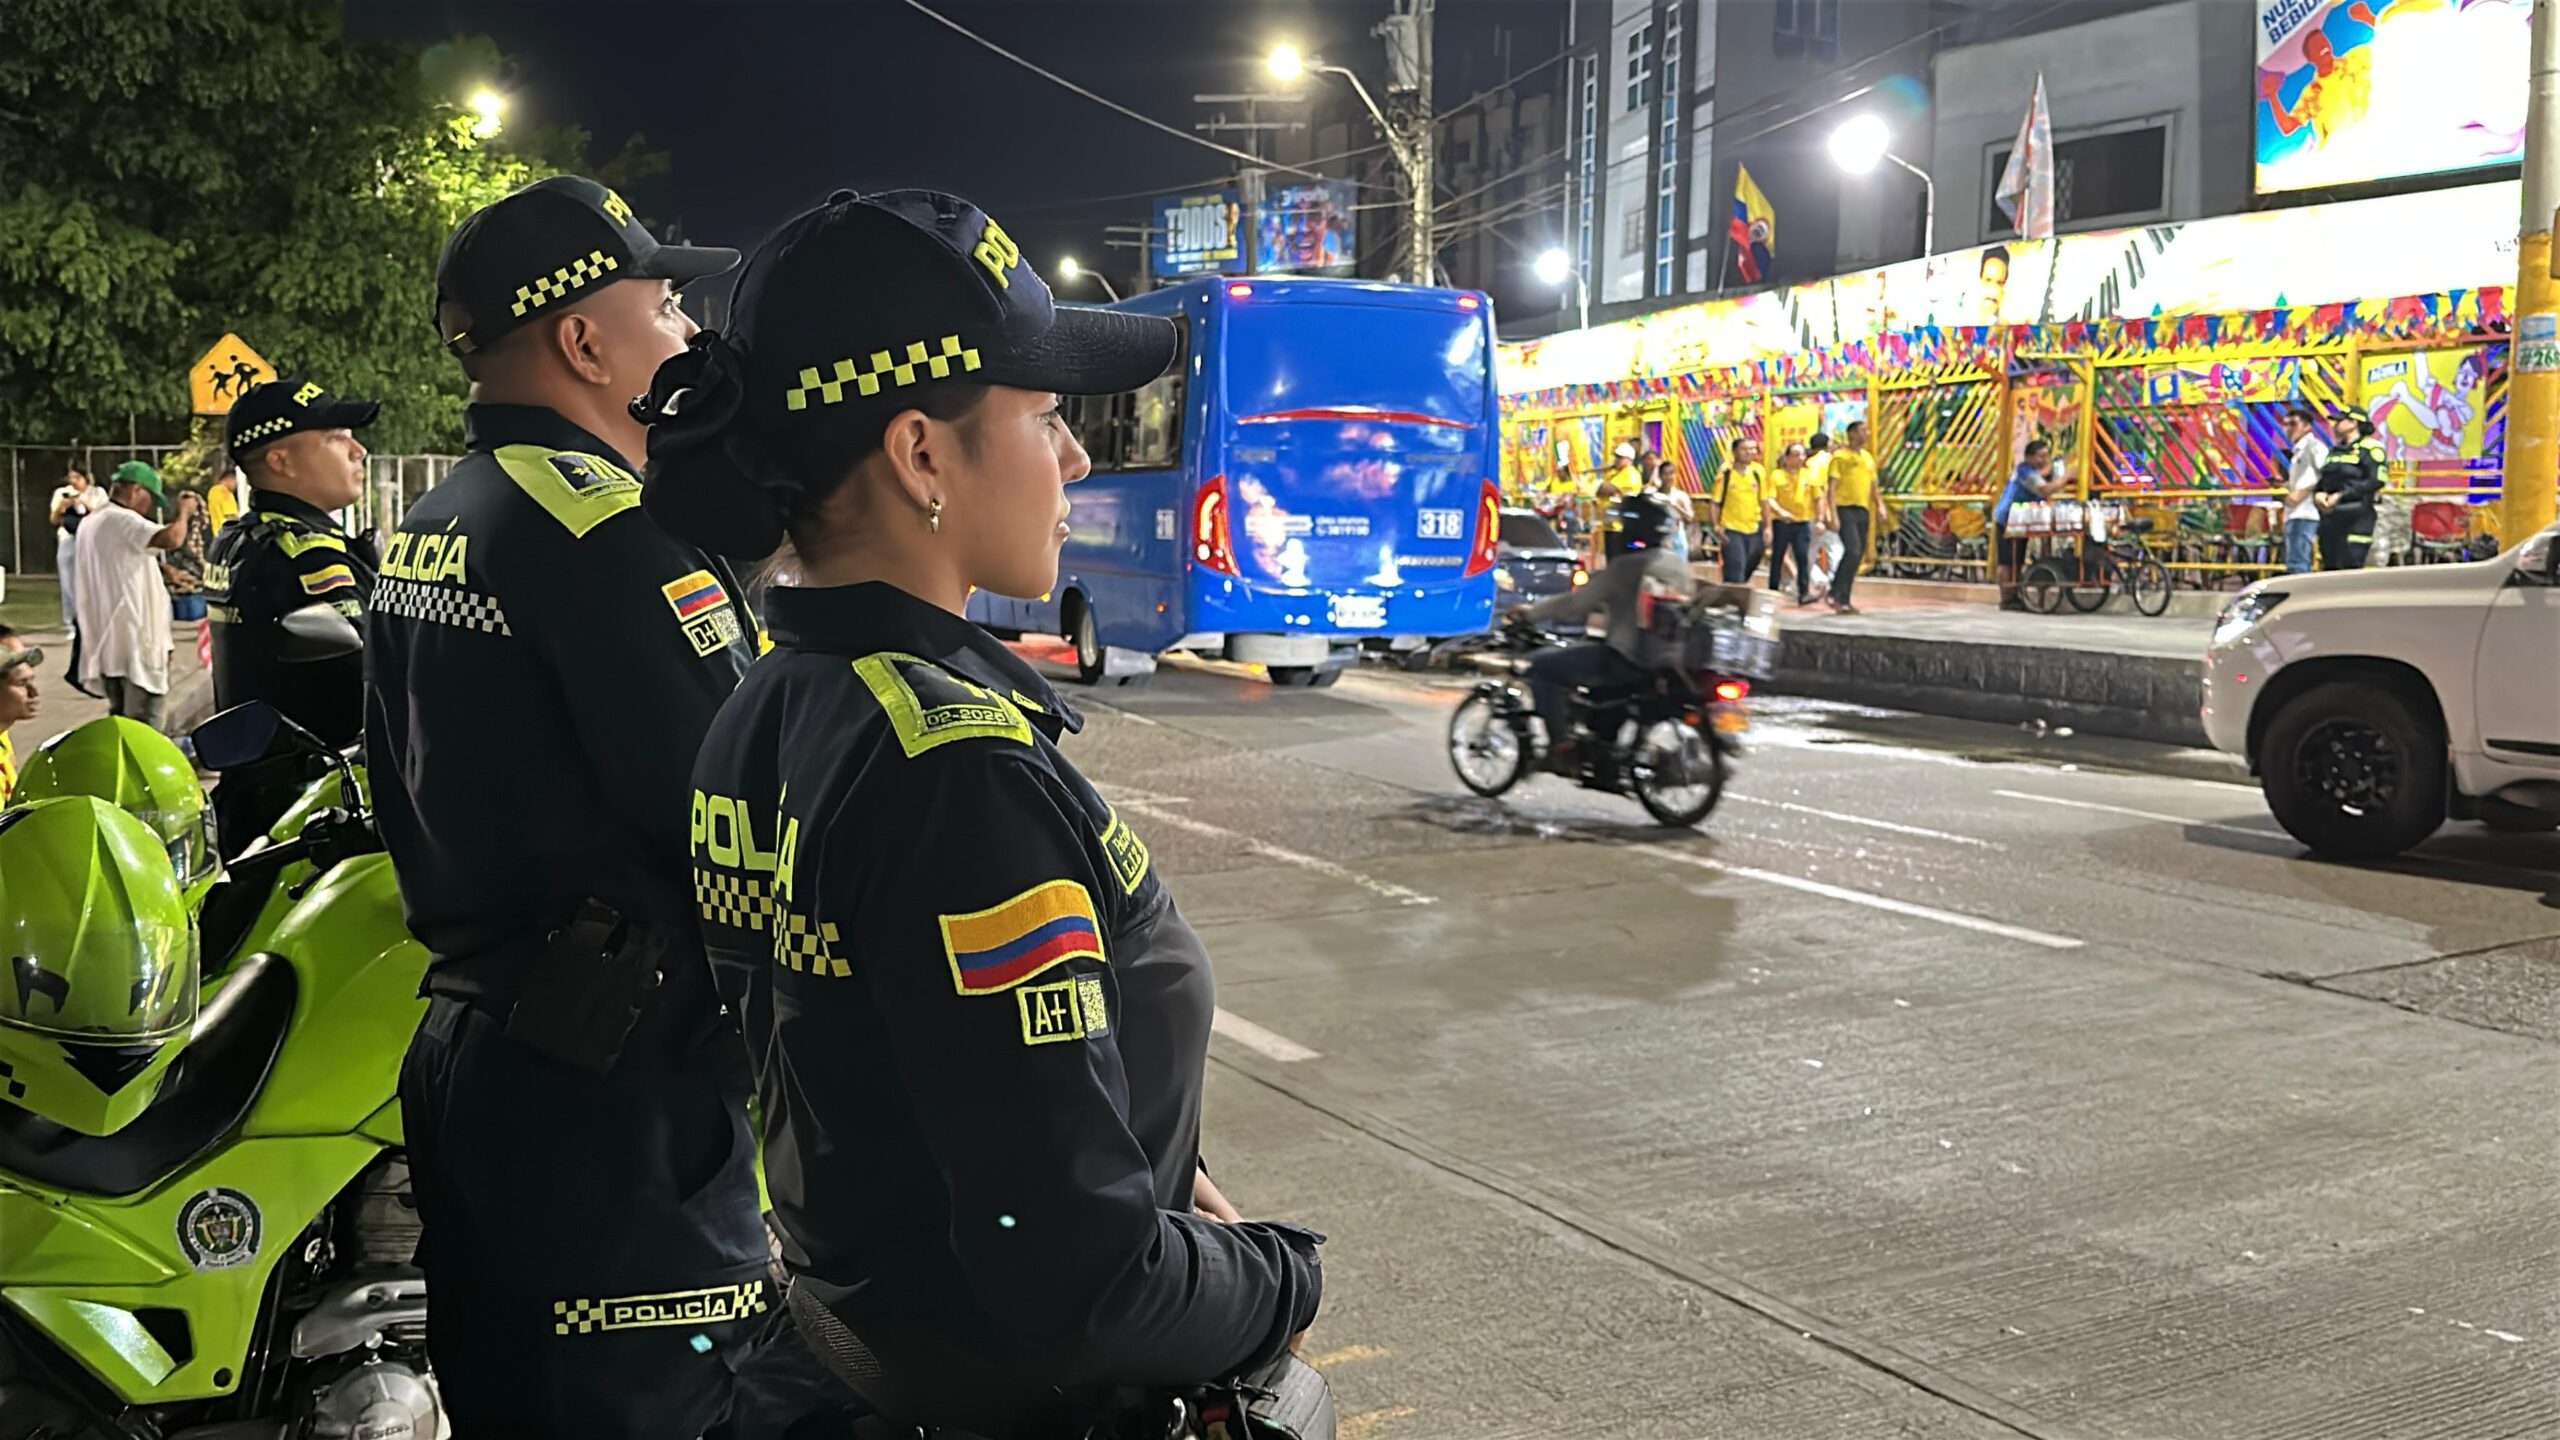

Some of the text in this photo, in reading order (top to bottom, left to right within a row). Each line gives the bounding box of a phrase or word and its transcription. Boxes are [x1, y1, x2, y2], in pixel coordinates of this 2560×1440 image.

[2269, 0, 2322, 44] BEBID
[973, 218, 1020, 290] PO
[1421, 512, 1460, 536] 318
[379, 515, 469, 585] OLICÍA
[690, 780, 799, 902] POLÍA
[1035, 991, 1067, 1035] A+
[614, 1295, 727, 1323] POLICÍA
